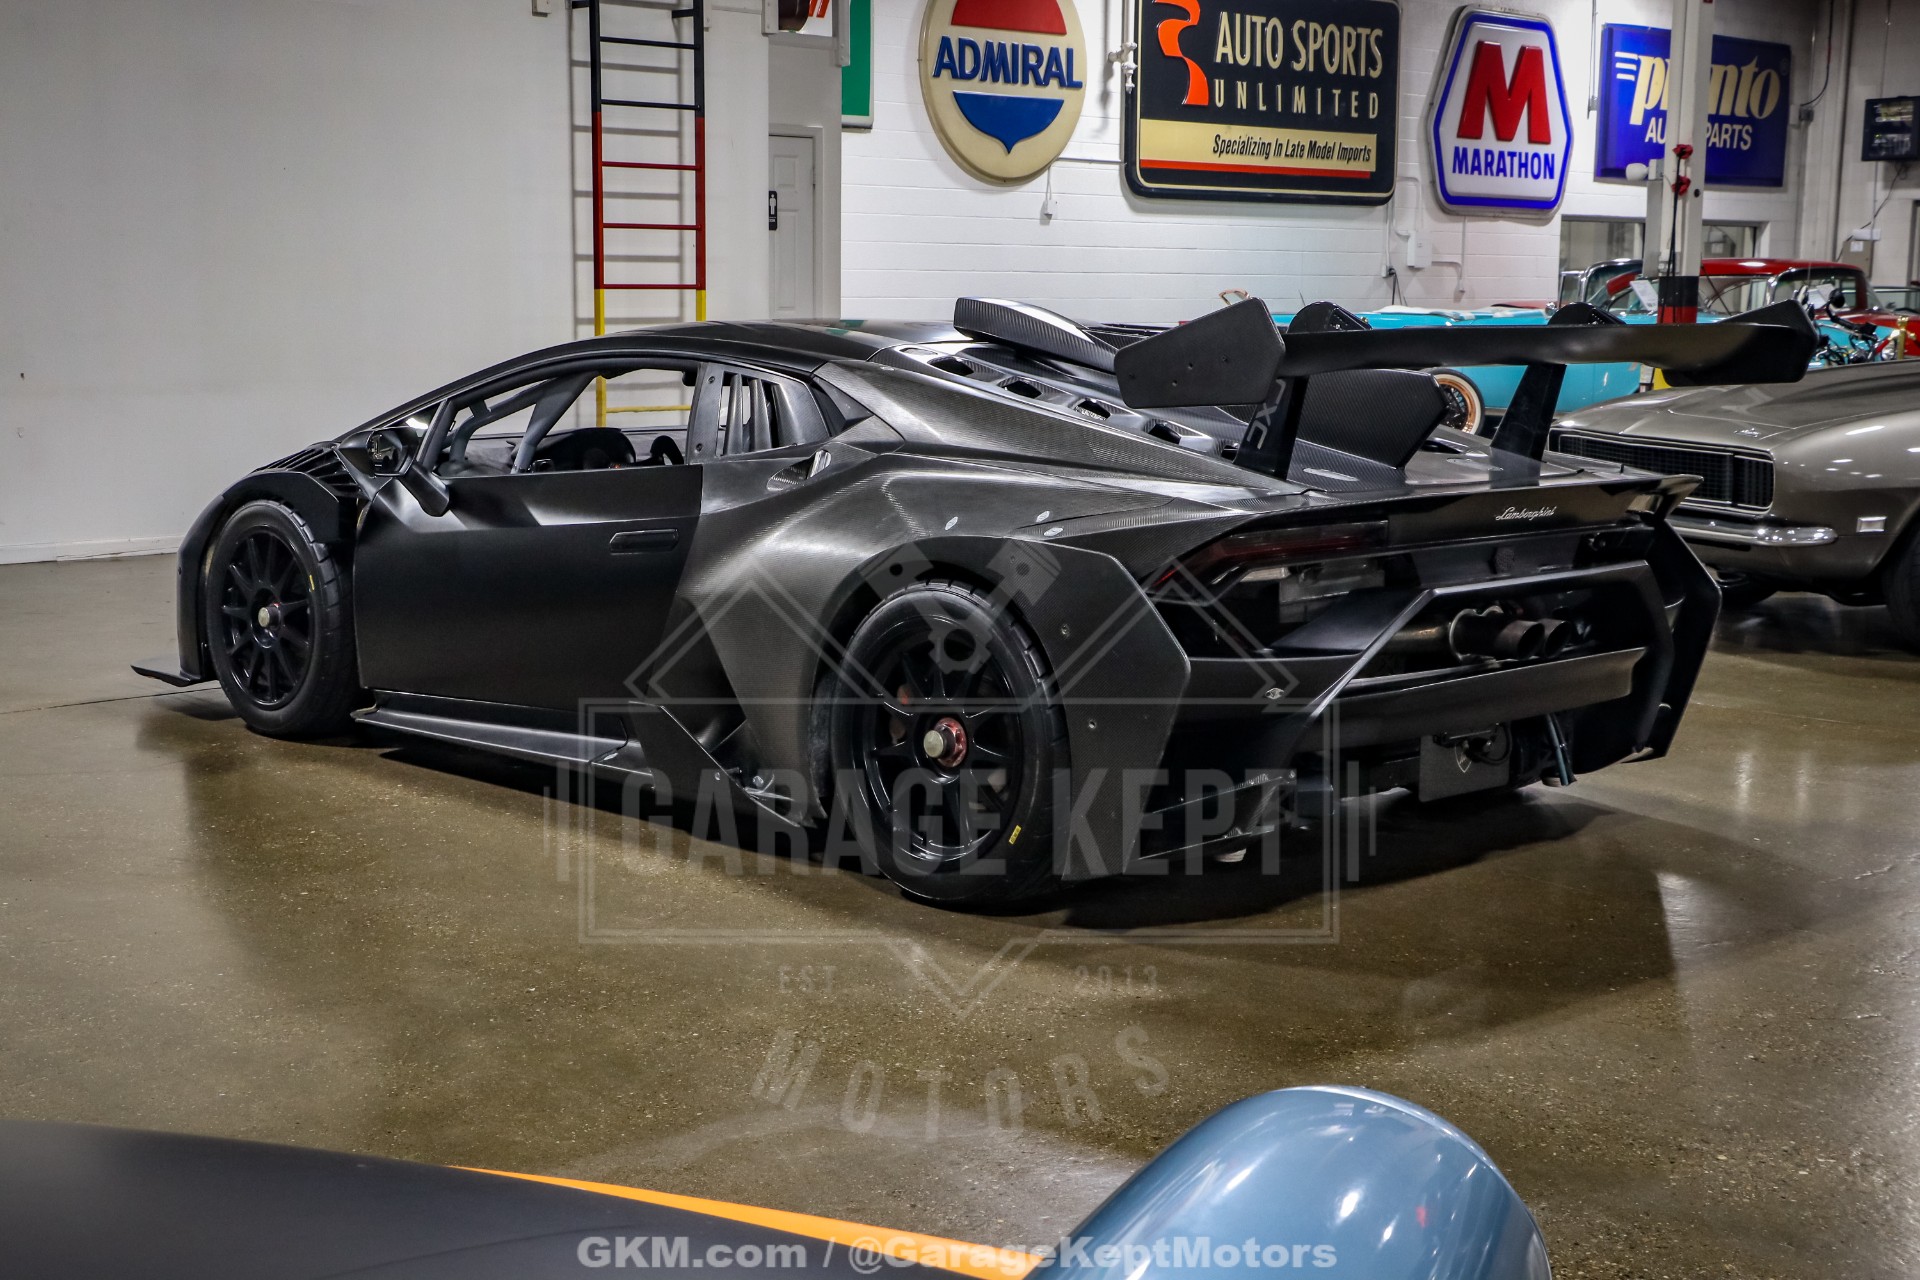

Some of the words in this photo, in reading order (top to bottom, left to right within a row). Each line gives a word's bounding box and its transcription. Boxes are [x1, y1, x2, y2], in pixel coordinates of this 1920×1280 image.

[932, 35, 1083, 89] ADMIRAL
[1214, 11, 1284, 69] AUTO
[1291, 19, 1383, 79] SPORTS
[1214, 78, 1379, 120] UNLIMITED
[1456, 40, 1551, 145] M
[1213, 133, 1271, 160] Specializing
[1273, 138, 1282, 156] In
[1284, 138, 1305, 159] Late
[1306, 140, 1336, 160] Model
[1337, 142, 1371, 165] Imports
[1452, 145, 1555, 180] MARATHON
[1495, 506, 1558, 521] Lamborghini
